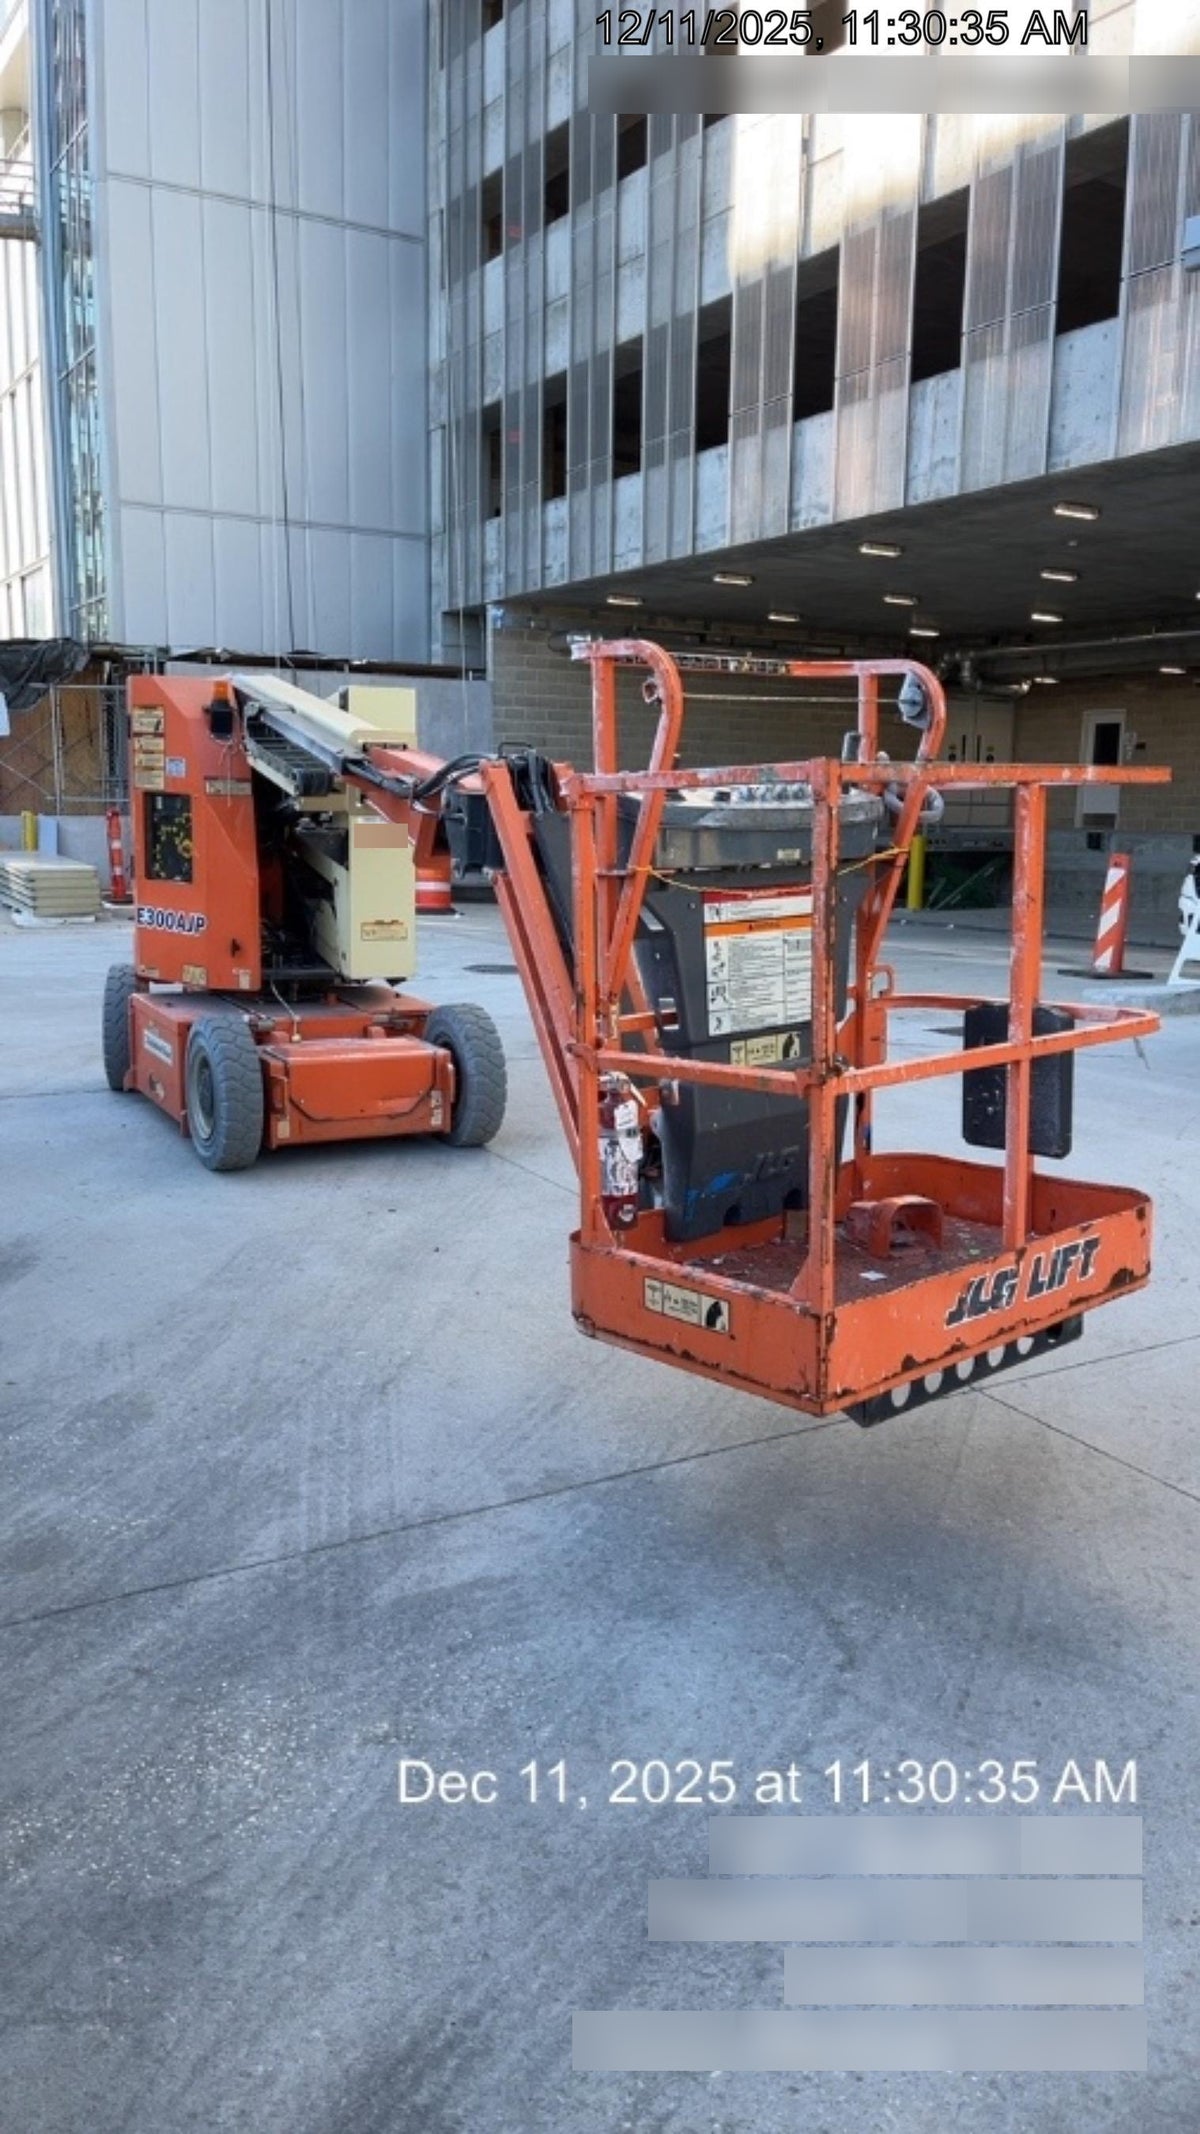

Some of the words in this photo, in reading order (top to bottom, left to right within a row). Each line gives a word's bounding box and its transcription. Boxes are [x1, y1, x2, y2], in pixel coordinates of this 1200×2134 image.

[137, 906, 207, 935] E300AJP
[945, 1266, 1019, 1330] JLG
[1025, 1235, 1100, 1301] LIFT
